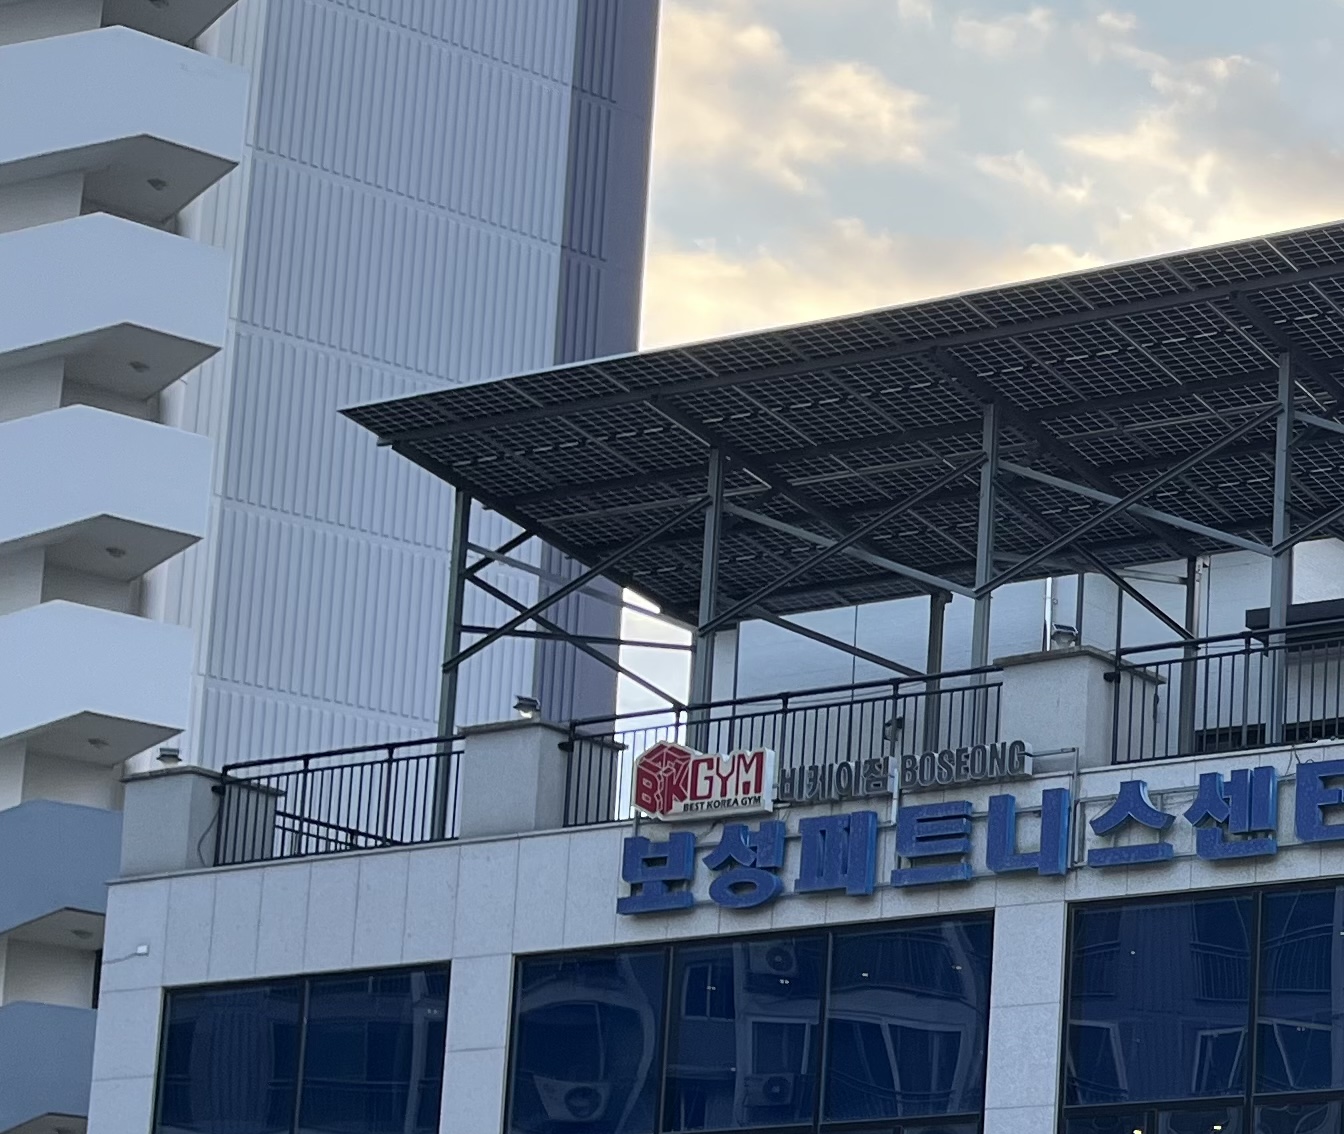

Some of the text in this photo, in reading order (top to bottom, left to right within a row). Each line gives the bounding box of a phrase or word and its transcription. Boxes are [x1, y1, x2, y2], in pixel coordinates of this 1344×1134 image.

[778, 757, 890, 800] 비케이짐
[901, 740, 1028, 788] BOSEONG
[683, 795, 762, 812] BEST KOREA GYM
